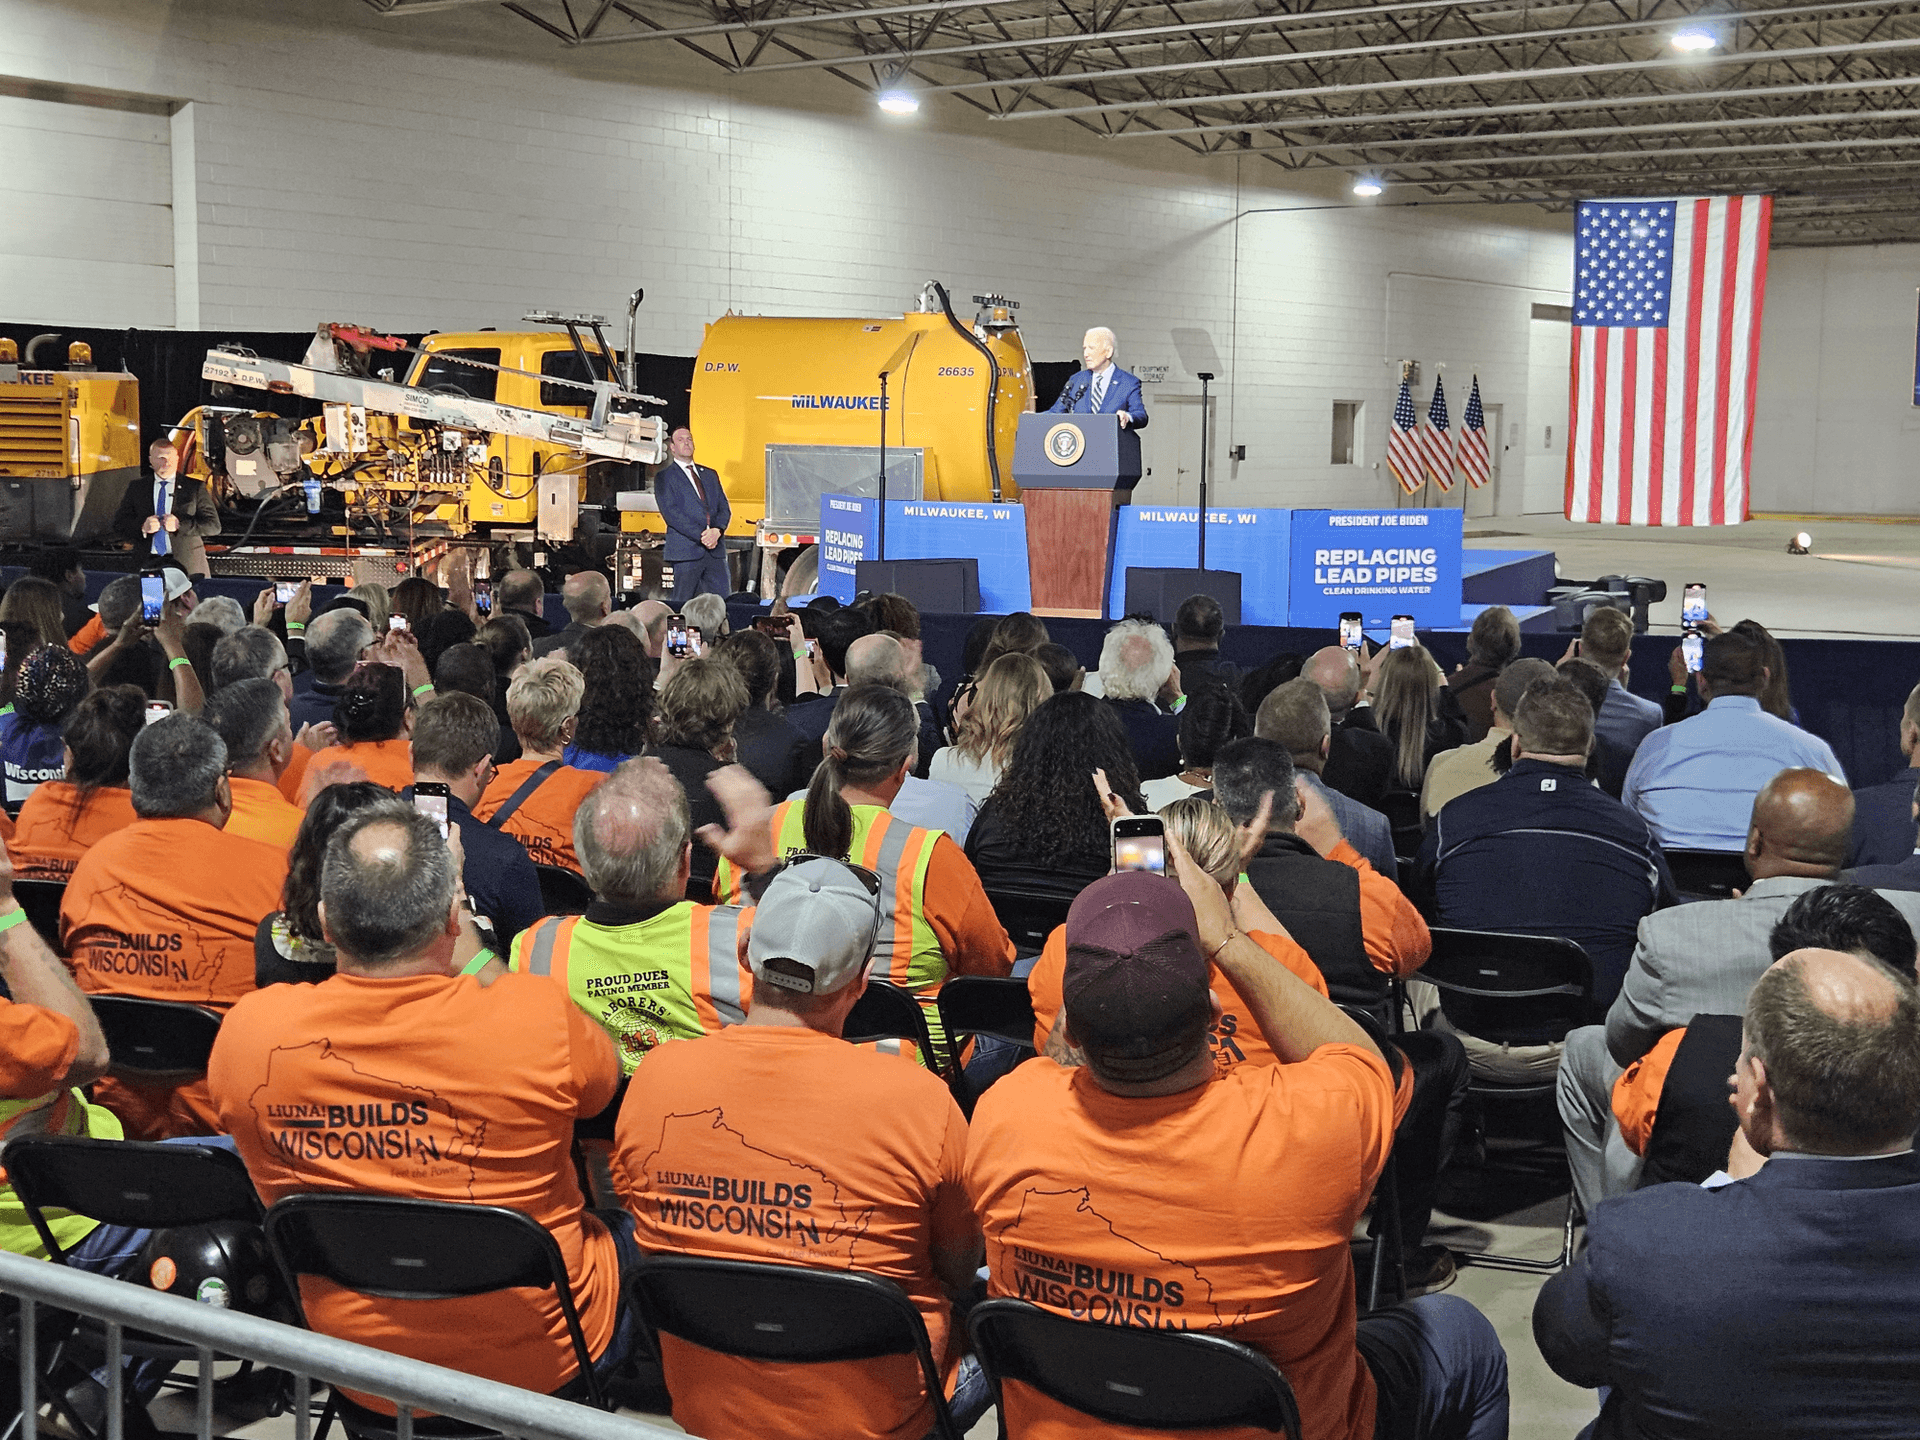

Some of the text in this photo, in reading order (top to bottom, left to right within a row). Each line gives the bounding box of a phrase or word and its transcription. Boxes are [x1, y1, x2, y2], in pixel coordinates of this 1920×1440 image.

[204, 366, 229, 377] 27192
[704, 362, 741, 372] D.P.W.
[938, 366, 975, 376] 26635
[404, 393, 430, 405] SIMCO
[791, 394, 890, 410] MILWAUKEE
[904, 506, 1011, 520] MILWAUKEE, WI
[1139, 511, 1258, 525] MILWAUEE, WI
[1328, 515, 1429, 526] PRESIDENT JOE BIDEN
[825, 529, 864, 549] REPLACING
[824, 546, 843, 562] LEAD
[1314, 548, 1438, 566] REPLACING
[1314, 566, 1438, 584] LEAD PIPES
[1322, 586, 1432, 595] CLEAN DRINKING WATER
[4, 760, 67, 780] Wisconsi
[119, 933, 182, 952] BUILDS
[88, 948, 189, 983] WISCONSIN
[586, 970, 669, 989] PROUD DUES
[587, 981, 670, 998] PAYING MEMBER
[601, 996, 672, 1021] ABORERS'
[620, 1029, 659, 1053] 113
[328, 1101, 429, 1129] BUILDS
[270, 1130, 441, 1166] WISCONSIN
[712, 1176, 812, 1209] BUILDS
[656, 1197, 821, 1247] WISCONSIN
[1074, 1263, 1184, 1308] BUILDS
